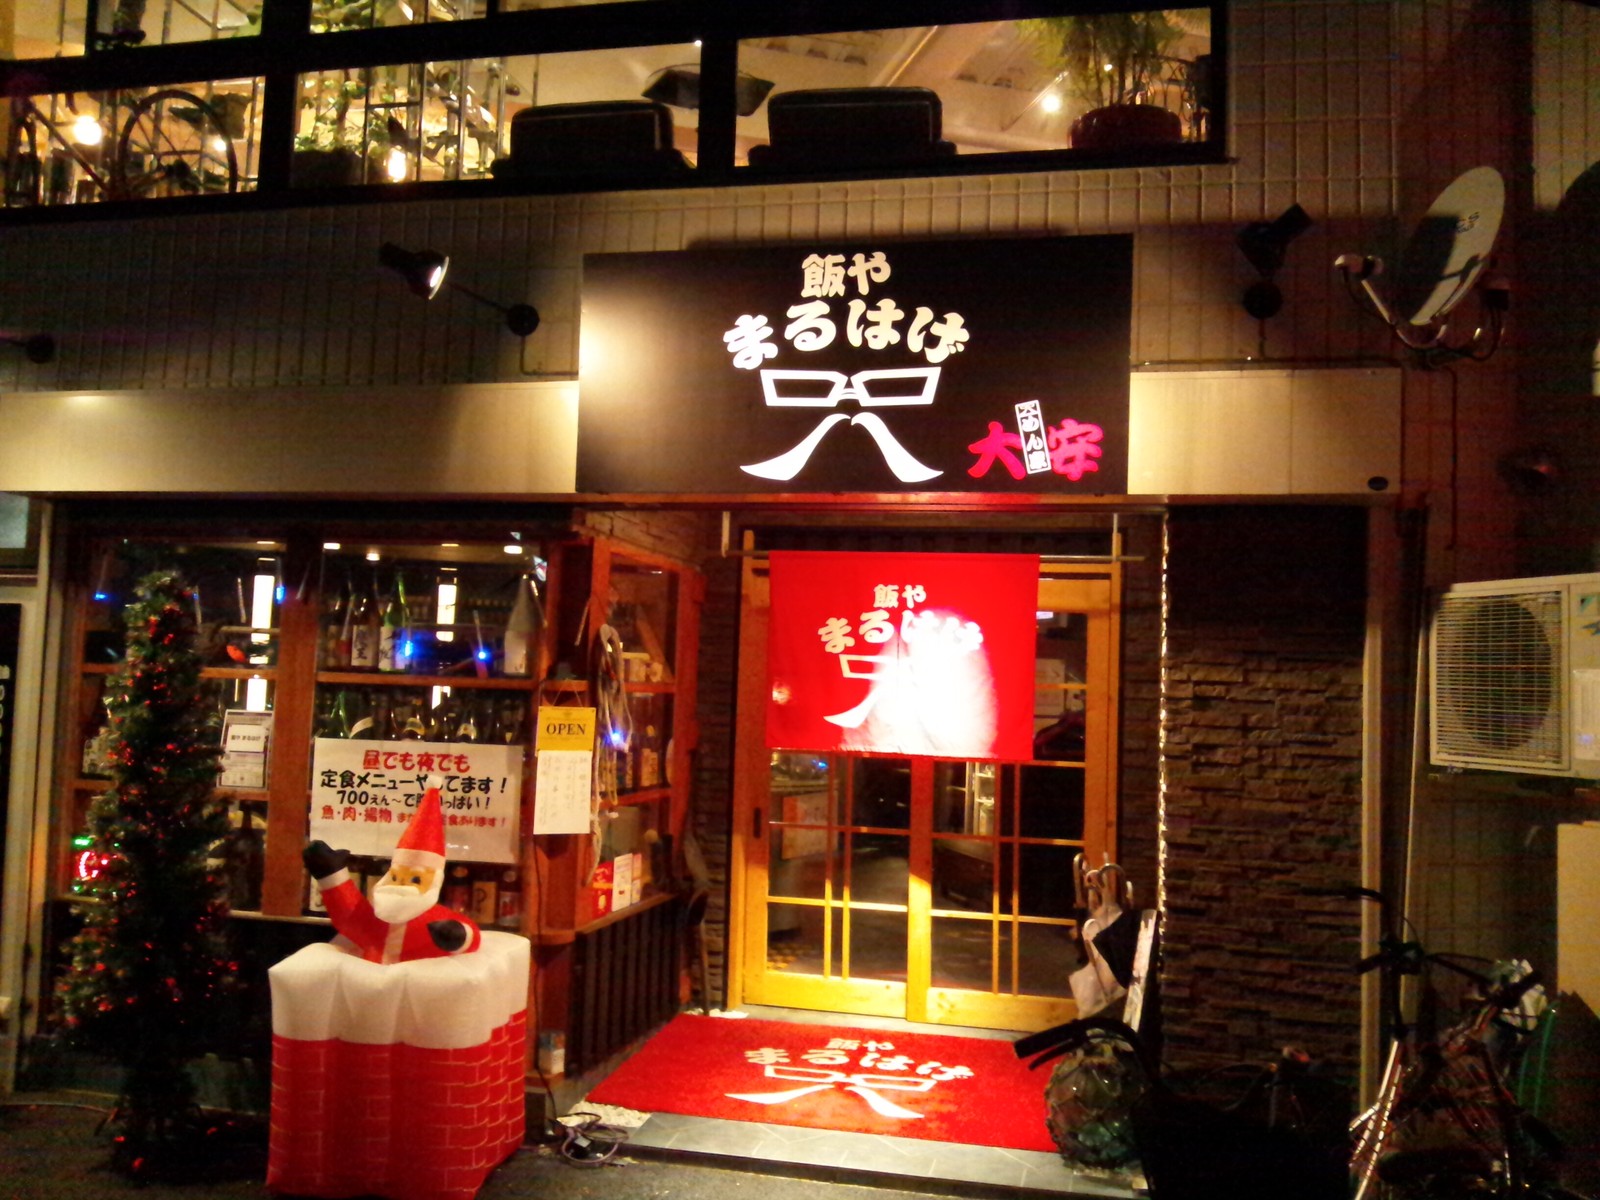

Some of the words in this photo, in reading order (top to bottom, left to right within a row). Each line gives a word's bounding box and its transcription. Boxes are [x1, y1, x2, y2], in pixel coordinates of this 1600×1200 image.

[801, 251, 891, 298] 飯や
[722, 298, 970, 371] まるはげ
[873, 583, 927, 608] 飯や
[545, 723, 587, 736] OPEN
[362, 749, 471, 774] 昼でも夜でも
[320, 769, 508, 794] 定食メニューやてます！
[825, 1038, 895, 1051] 飯や
[744, 1047, 975, 1081] まるはげ
